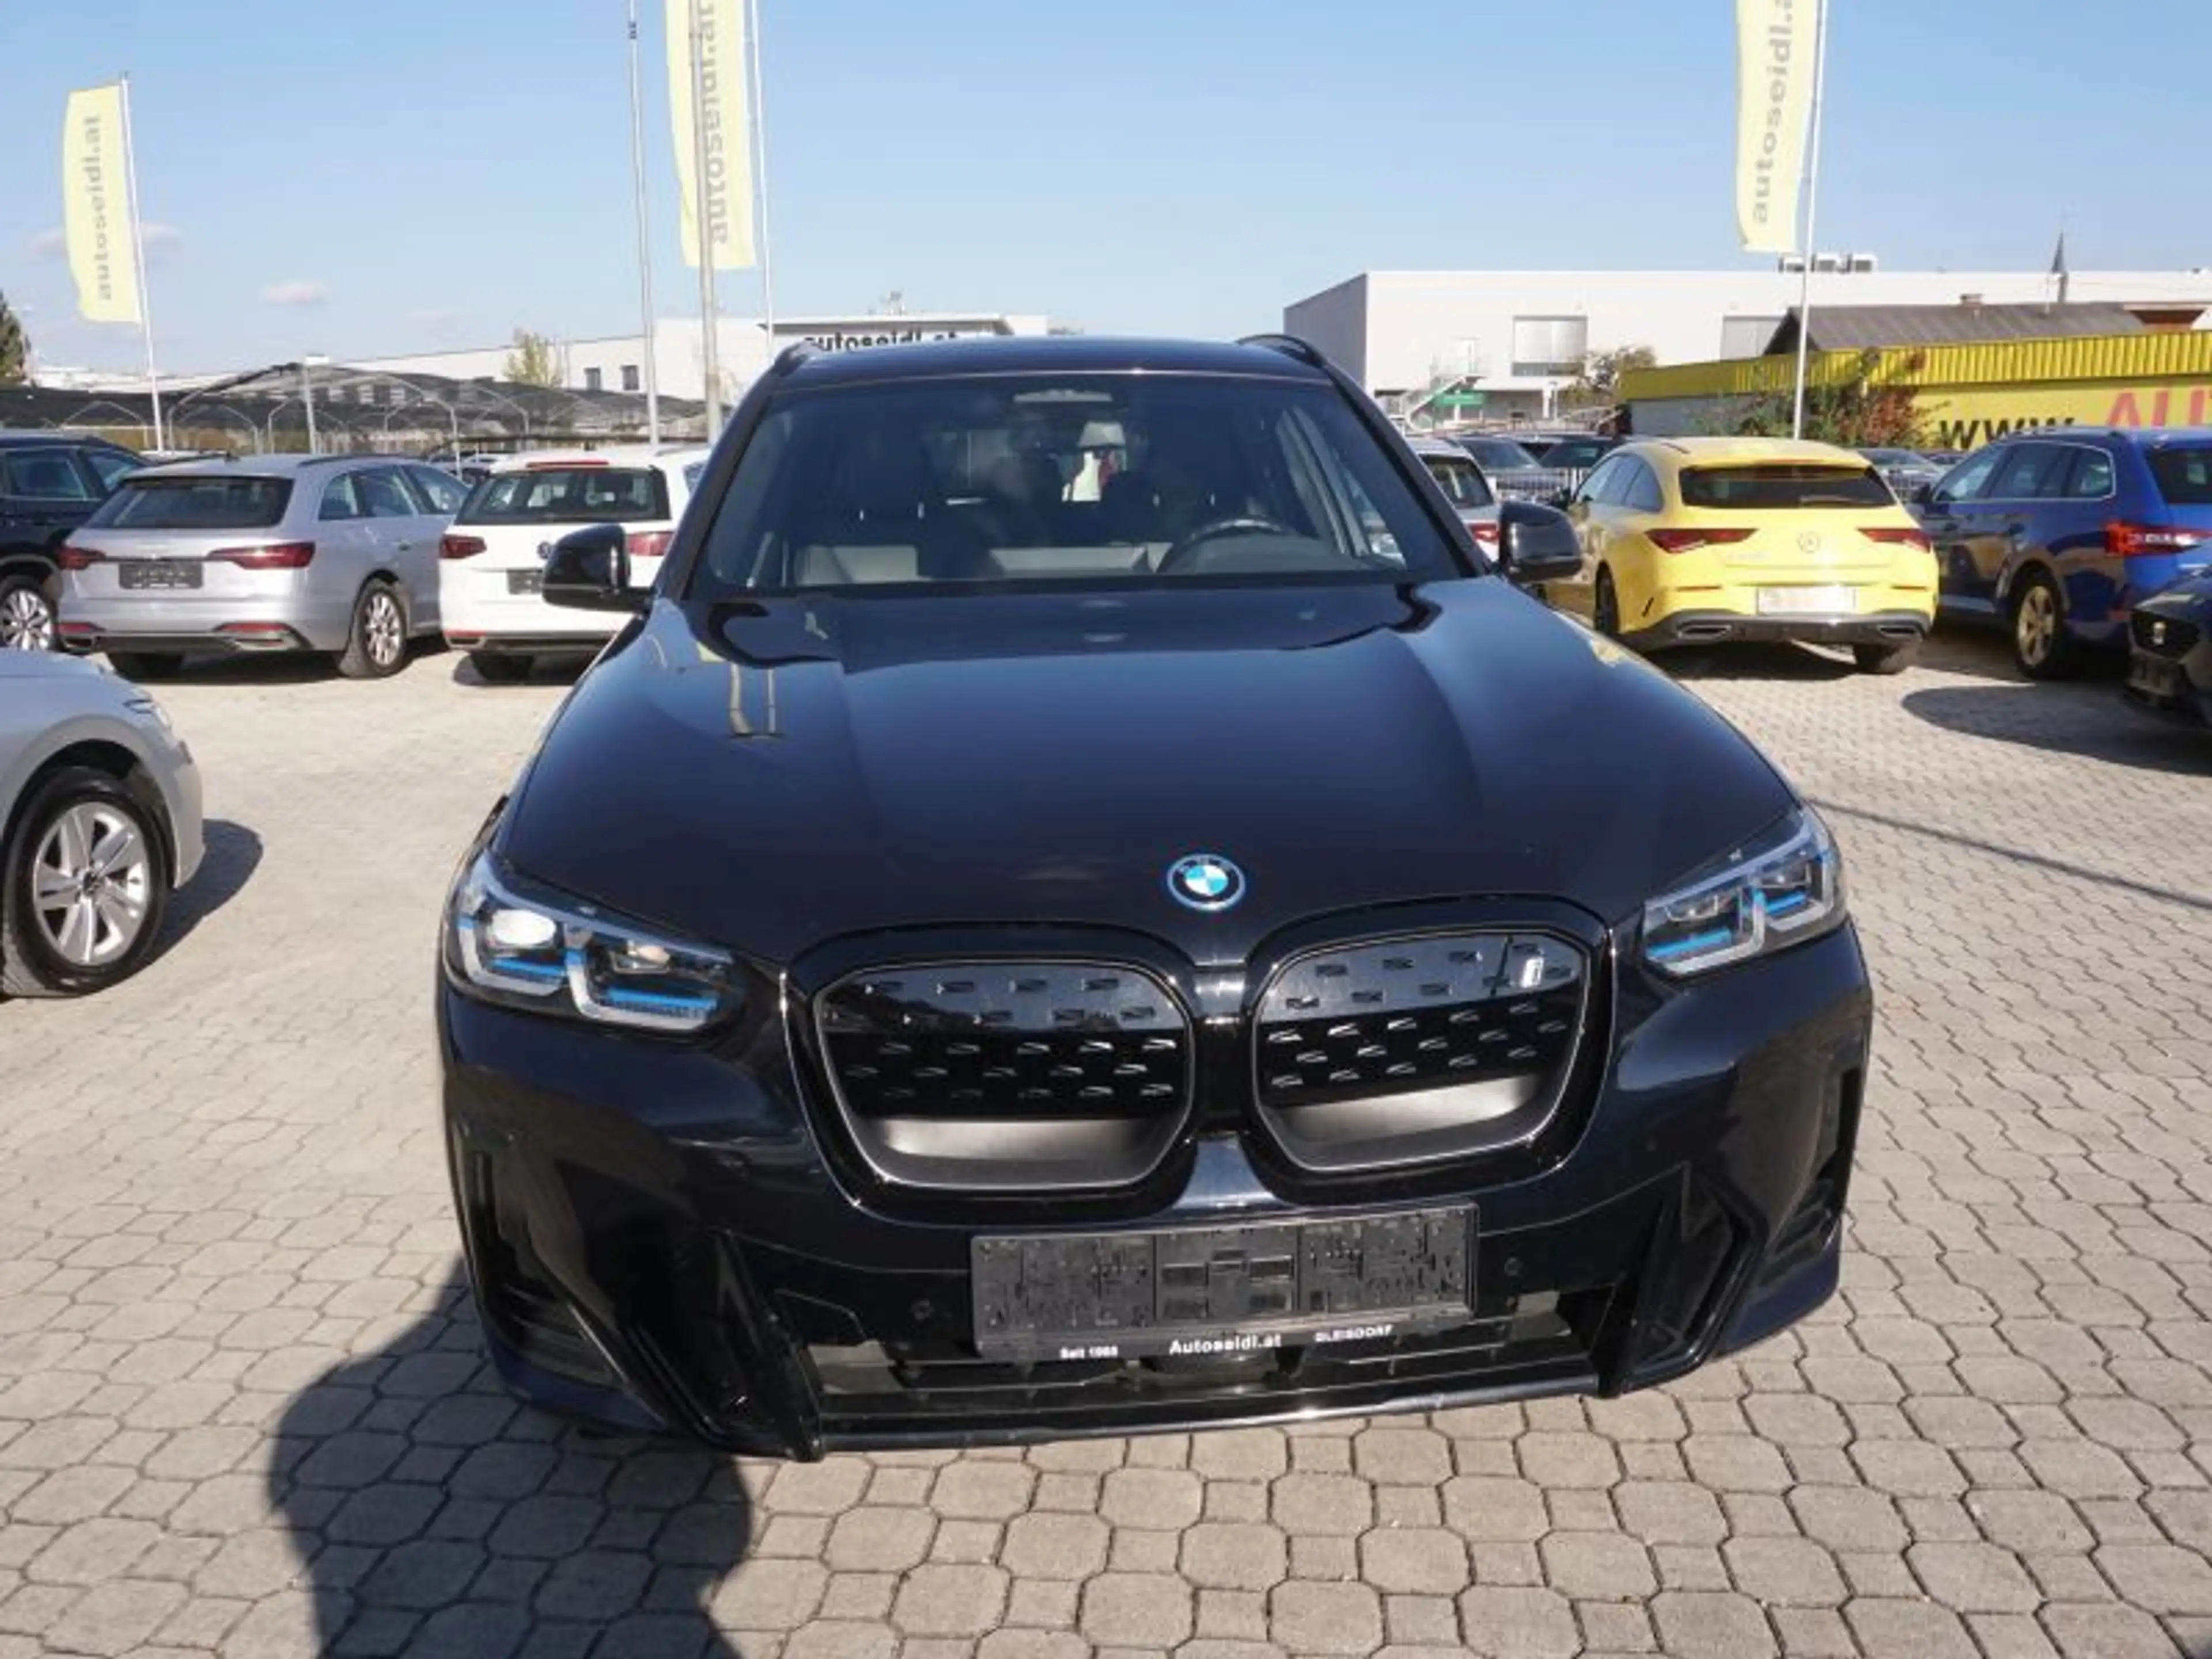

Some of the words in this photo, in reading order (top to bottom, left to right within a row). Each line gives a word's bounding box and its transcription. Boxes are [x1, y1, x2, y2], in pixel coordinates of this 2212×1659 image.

[81, 116, 112, 300] autoseidl.at
[2107, 391, 2212, 427] AU
[1169, 1333, 1281, 1355] Autoseidl.at
